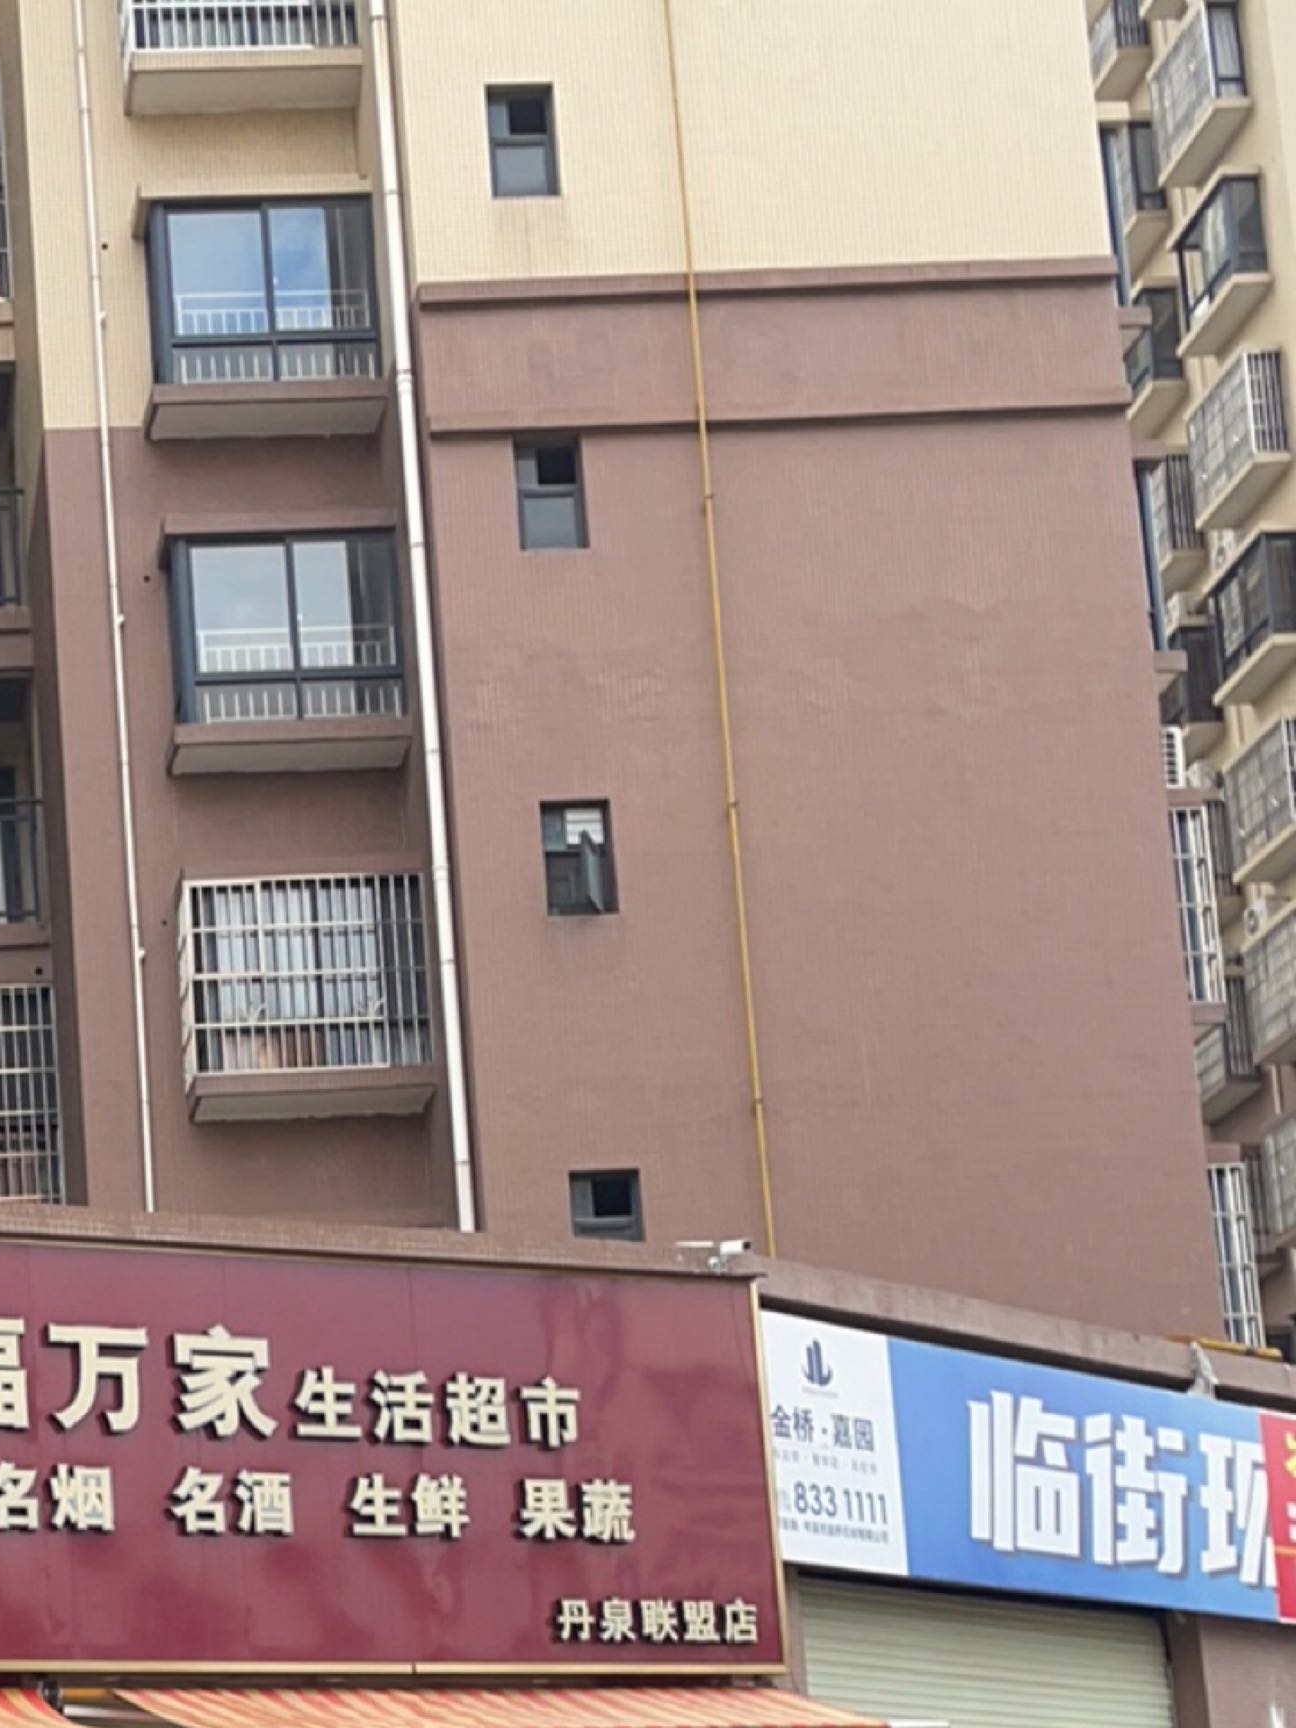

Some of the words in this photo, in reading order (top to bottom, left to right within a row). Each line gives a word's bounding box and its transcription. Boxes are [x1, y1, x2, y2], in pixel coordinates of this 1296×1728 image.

[295, 1365, 581, 1448] 生活超市
[172, 1466, 295, 1535] 名酒
[350, 1472, 471, 1539] 生鲜
[519, 1477, 636, 1544] 果蔬
[556, 1597, 758, 1645] 丹泉联盟店
